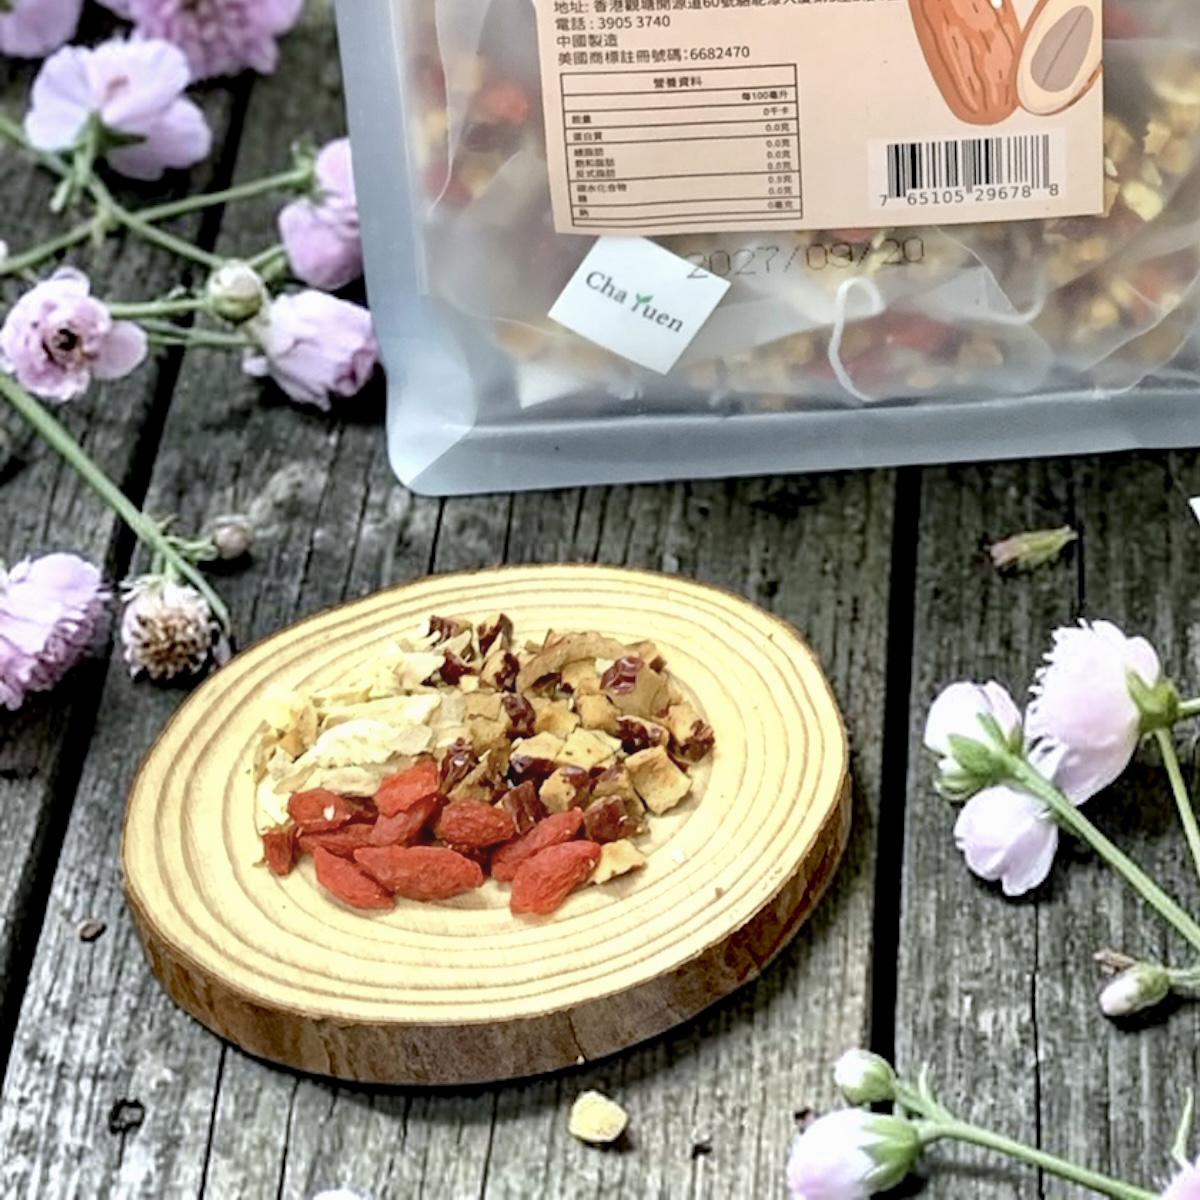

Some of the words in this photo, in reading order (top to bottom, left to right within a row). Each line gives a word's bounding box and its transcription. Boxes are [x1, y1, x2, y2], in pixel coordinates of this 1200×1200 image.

[598, 16, 633, 30] 3905
[636, 14, 671, 28] 3740
[556, 33, 618, 49] 中國製造
[879, 194, 888, 207] 7
[907, 189, 964, 205] 65105
[975, 185, 1031, 201] 29678
[1049, 184, 1059, 197] 8
[686, 237, 925, 280] 2027/09/20
[585, 270, 628, 304] Cha
